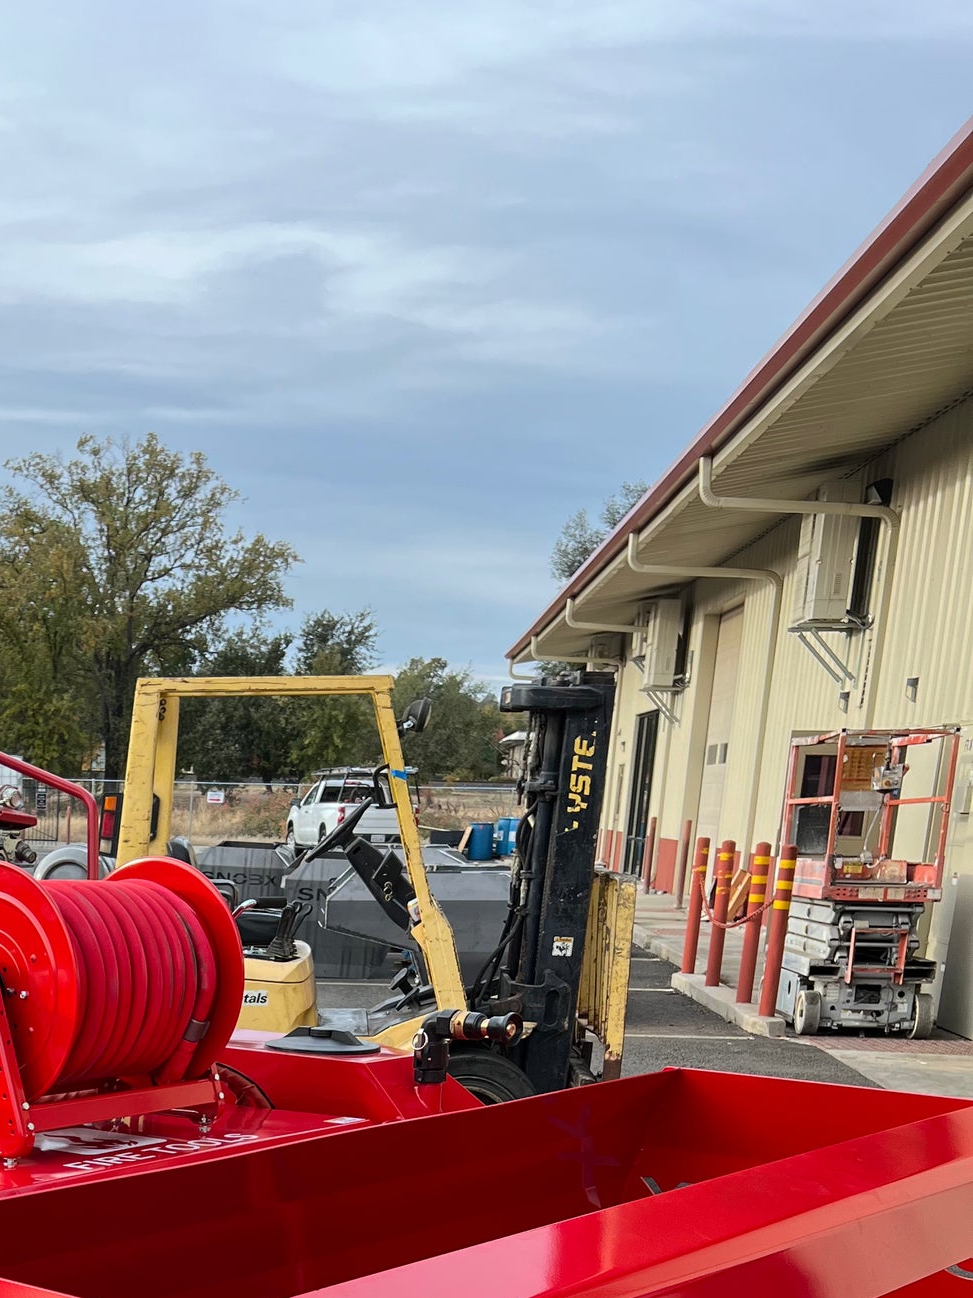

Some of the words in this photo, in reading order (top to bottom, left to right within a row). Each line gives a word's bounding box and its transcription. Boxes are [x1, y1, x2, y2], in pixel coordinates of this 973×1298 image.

[566, 724, 597, 831] YSTE
[243, 993, 267, 1003] tals
[63, 1151, 156, 1171] FIRE
[141, 1132, 259, 1155] TOOLS
